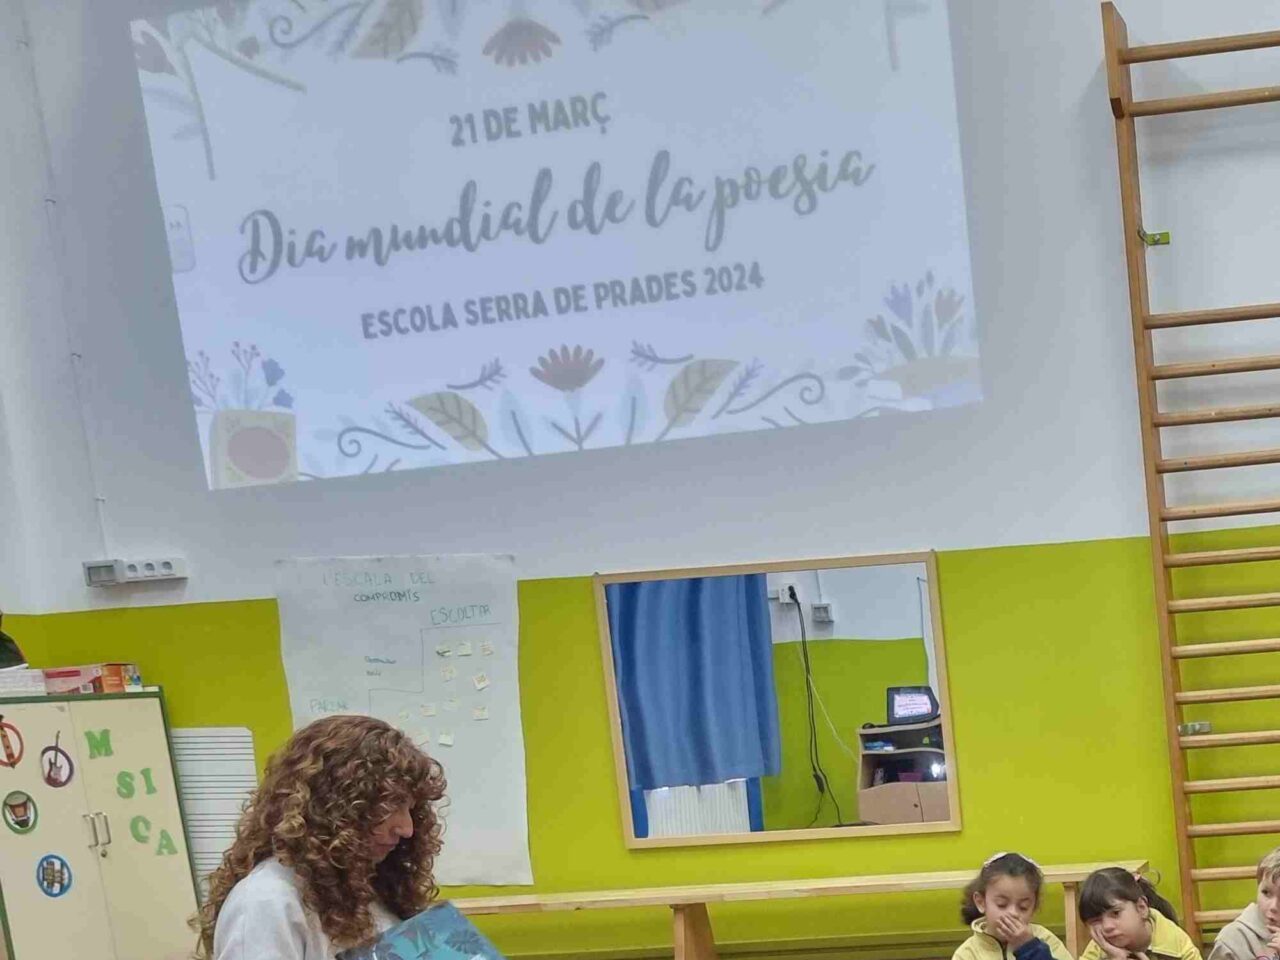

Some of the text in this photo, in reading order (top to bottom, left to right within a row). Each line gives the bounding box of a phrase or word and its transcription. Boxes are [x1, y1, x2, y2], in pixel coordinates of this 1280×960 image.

[450, 92, 611, 148] 21 DE MARÇ
[237, 146, 875, 286] Dia mundial de la poesia
[361, 260, 765, 341] ESCOLA SERRA DE PRADES 2024
